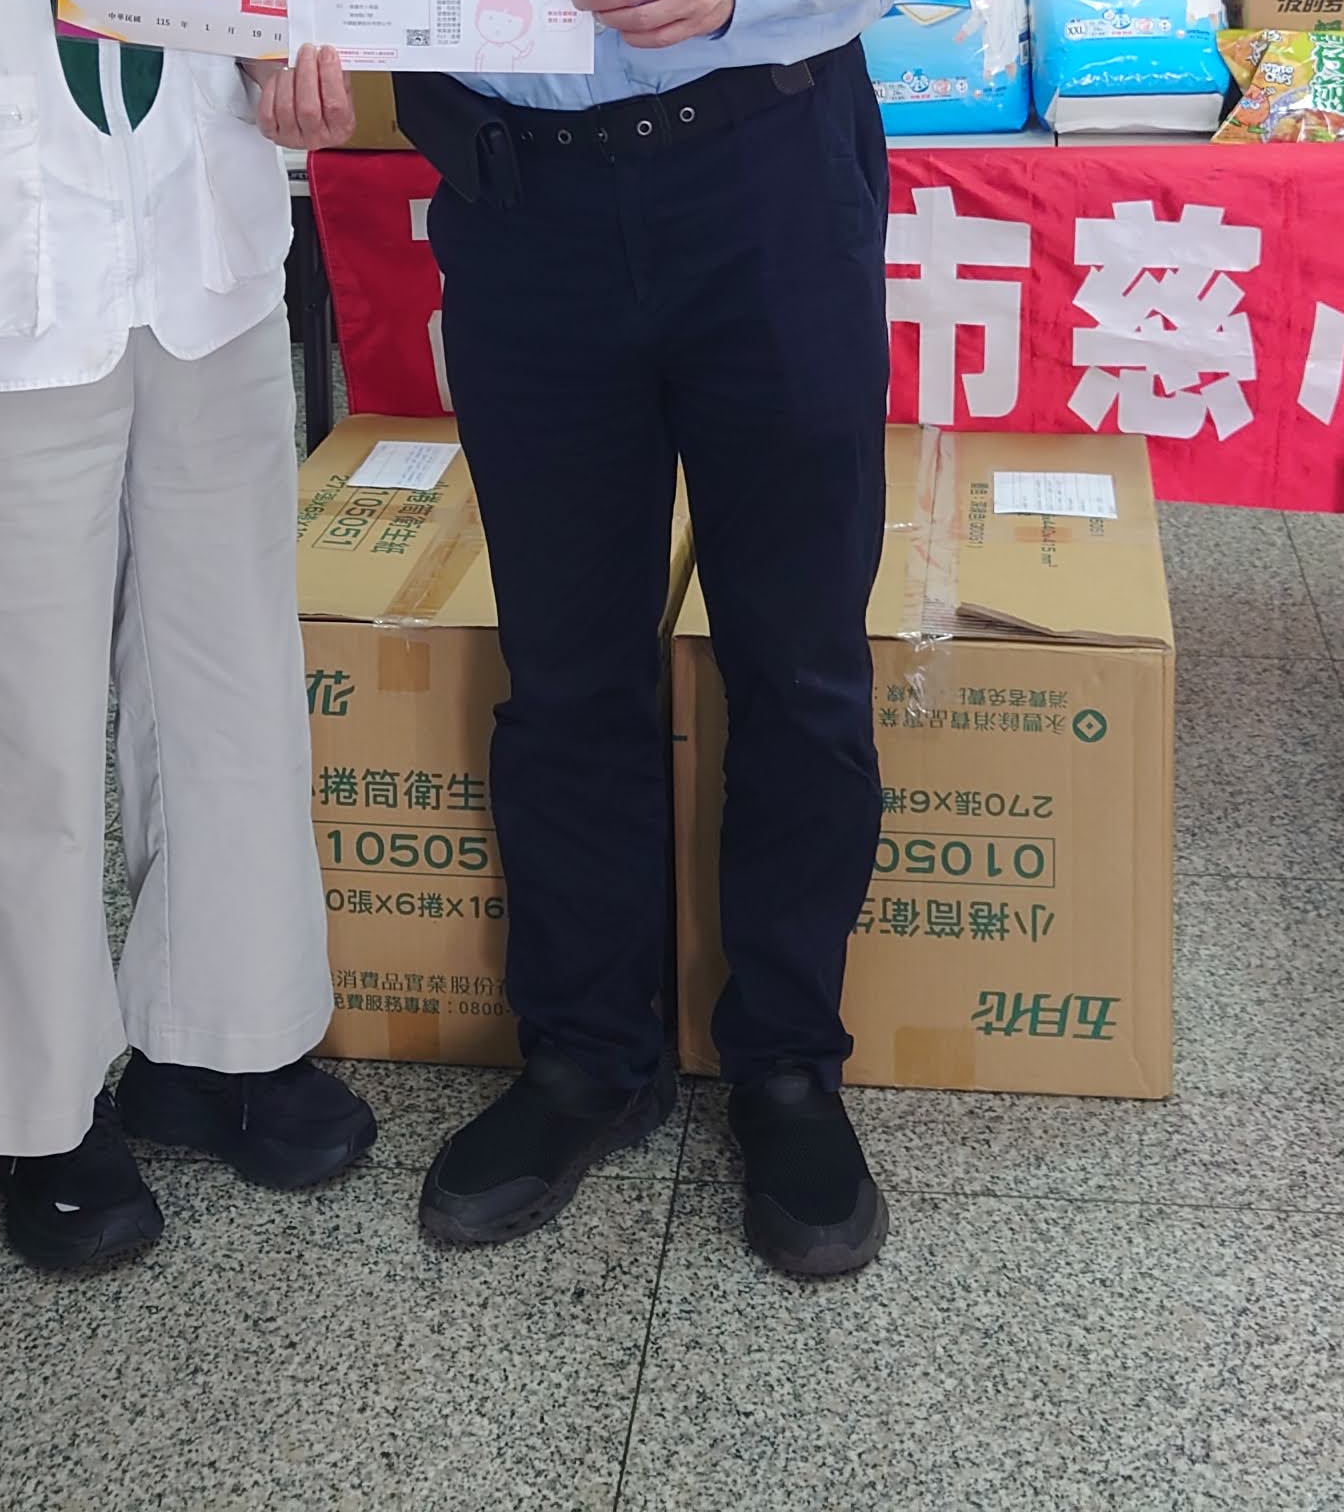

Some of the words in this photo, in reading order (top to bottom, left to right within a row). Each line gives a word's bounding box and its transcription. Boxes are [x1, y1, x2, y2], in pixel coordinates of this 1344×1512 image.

[108, 11, 142, 23] 中華民國
[156, 17, 171, 26] 115
[1067, 26, 1084, 36] XXL
[1261, 63, 1294, 76] POTATO
[1264, 73, 1293, 86] CHIPS
[312, 766, 487, 812] 捲筒衛生
[332, 969, 507, 997] 消費品實業股份
[970, 990, 1122, 1041] 五月花
